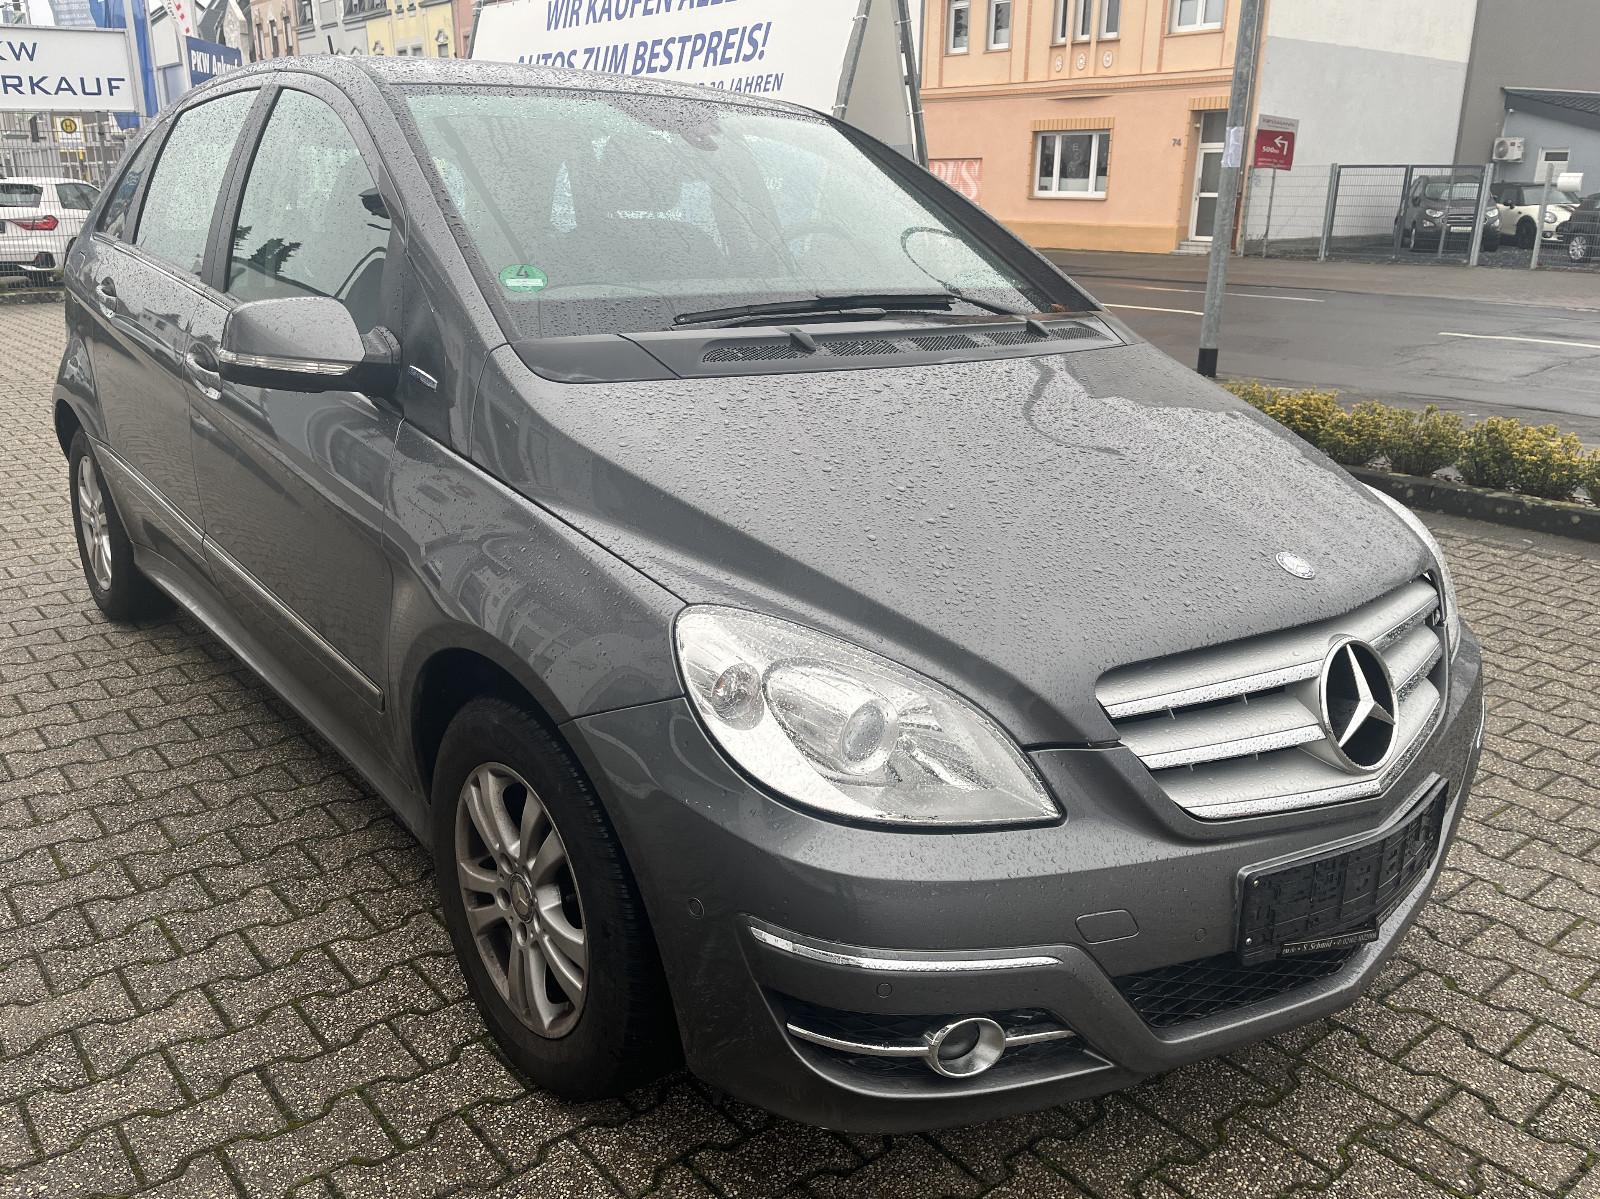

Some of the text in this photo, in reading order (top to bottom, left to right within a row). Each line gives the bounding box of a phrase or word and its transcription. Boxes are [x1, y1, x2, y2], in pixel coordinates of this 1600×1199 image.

[547, 0, 582, 31] WIR
[0, 41, 37, 61] W
[191, 49, 210, 74] PKW
[631, 21, 772, 75] BESTPREIS!
